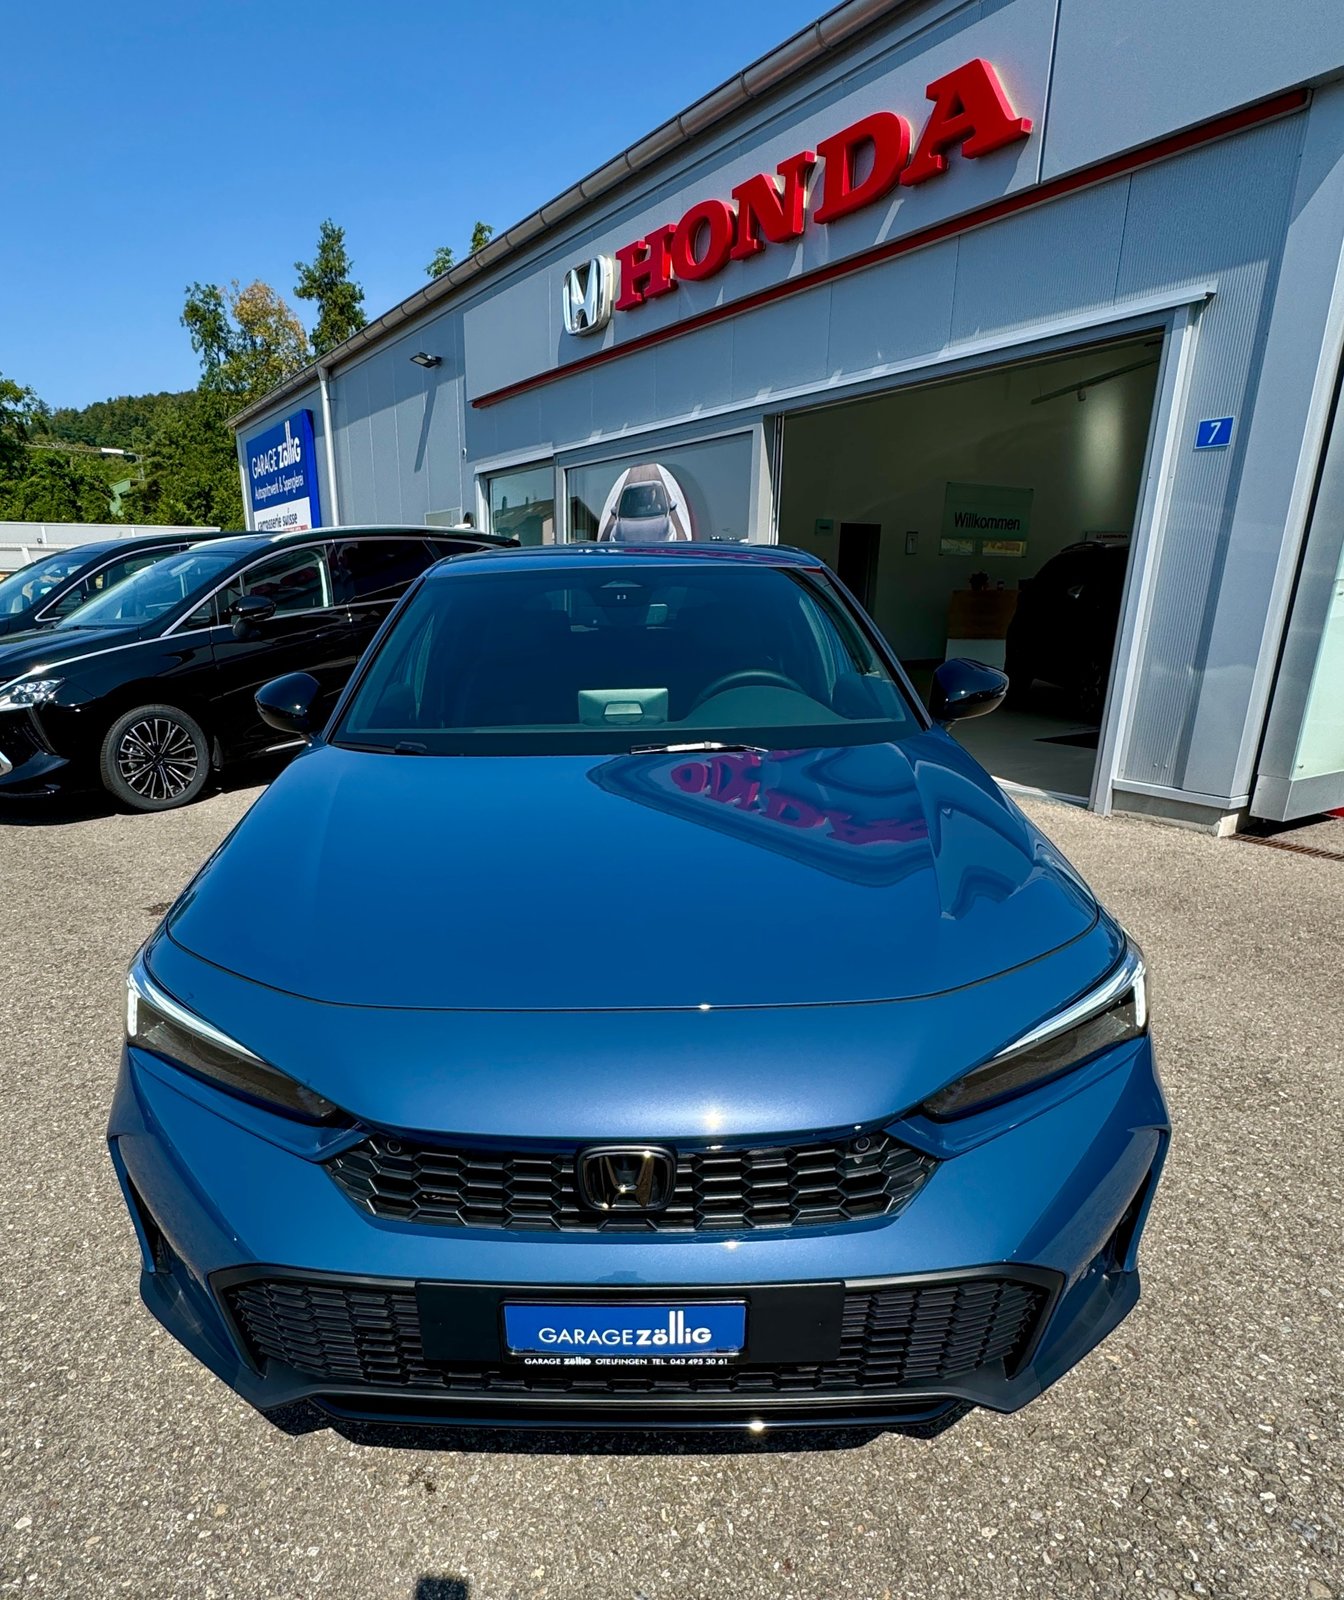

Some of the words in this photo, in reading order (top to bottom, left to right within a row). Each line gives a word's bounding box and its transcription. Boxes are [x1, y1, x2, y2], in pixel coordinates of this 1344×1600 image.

[615, 57, 1033, 311] HONDA
[1207, 421, 1222, 444] 7
[252, 448, 278, 479] GARAGE
[255, 479, 279, 503] Autospritzwerk
[279, 479, 283, 492] &
[282, 469, 304, 495] Spenglerei
[282, 507, 298, 526] suisse
[954, 511, 1021, 531] Willkommen
[538, 1326, 634, 1345] GARAGE
[524, 1356, 561, 1365] GARAGE
[595, 1357, 648, 1365] OTELFINGEN
[669, 1356, 686, 1365] 043
[687, 1356, 704, 1365] 495
[705, 1356, 716, 1365] 30
[718, 1356, 728, 1365] 61
